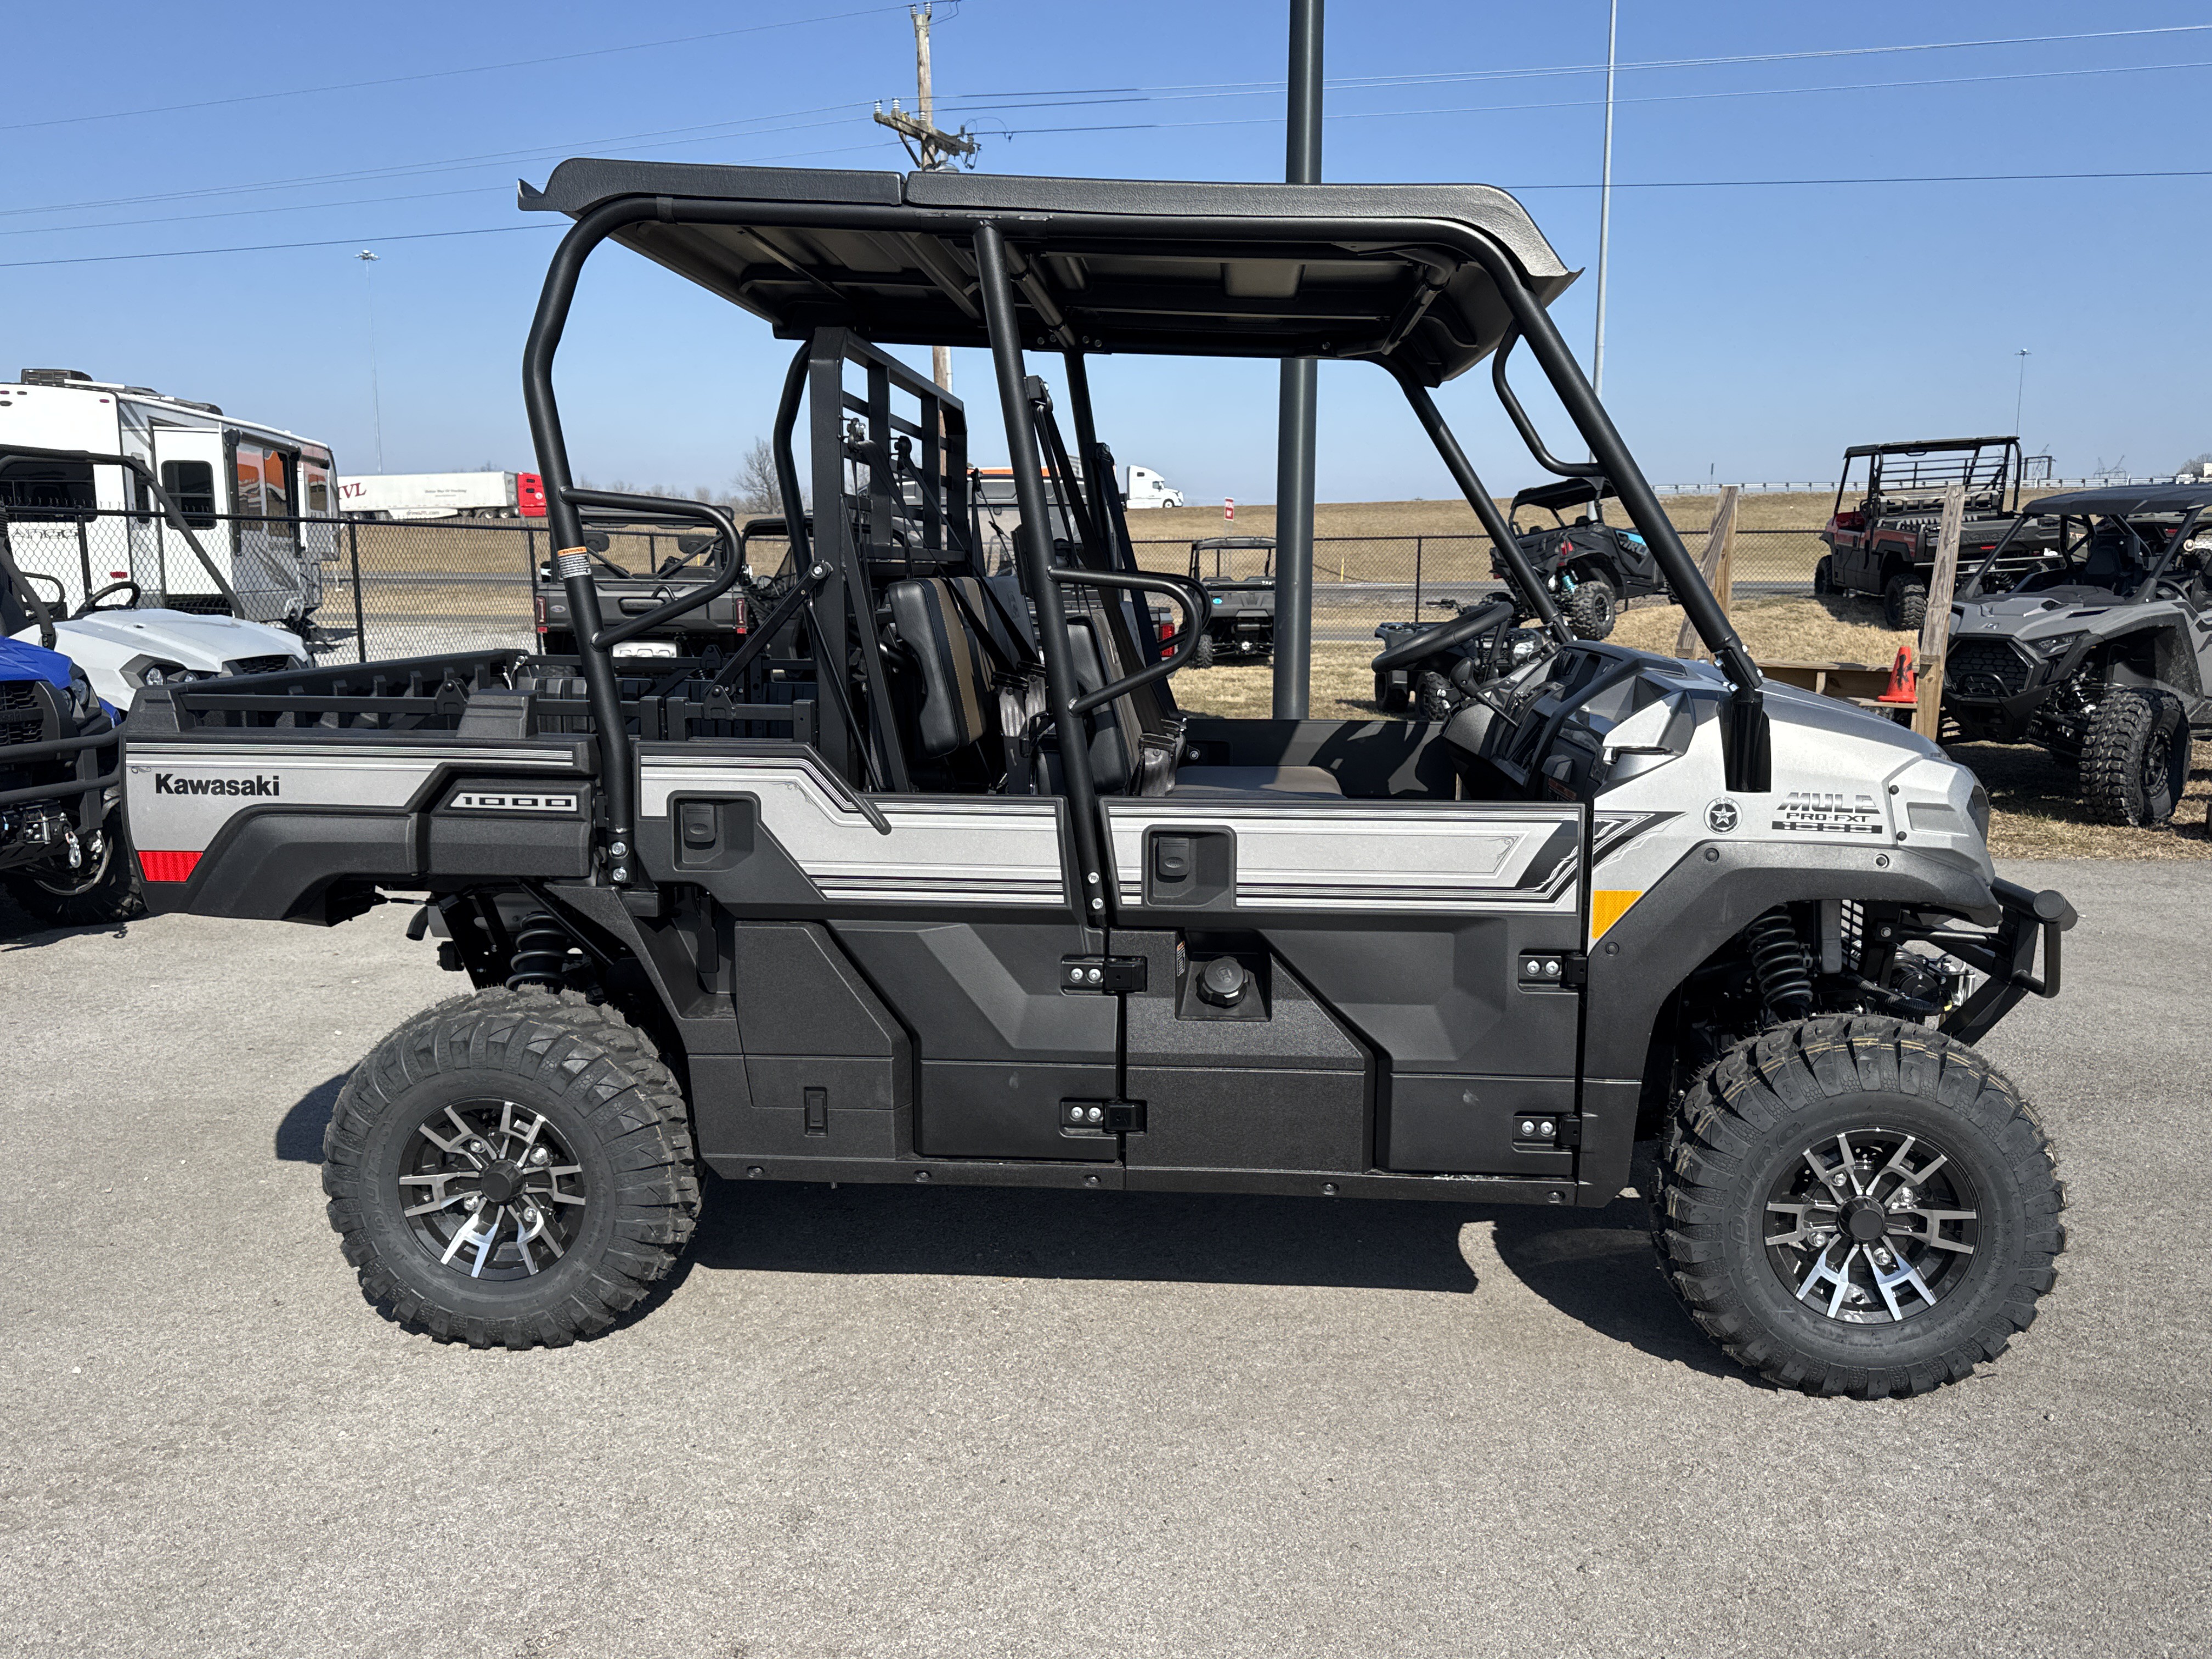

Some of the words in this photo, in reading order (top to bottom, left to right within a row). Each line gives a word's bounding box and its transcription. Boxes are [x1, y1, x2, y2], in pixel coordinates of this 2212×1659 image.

[155, 773, 279, 796] Kawasaki
[463, 797, 572, 806] 1000
[1776, 792, 1881, 814] MULE
[1784, 822, 1872, 833] 1000
[1730, 1122, 1802, 1246] DURO
